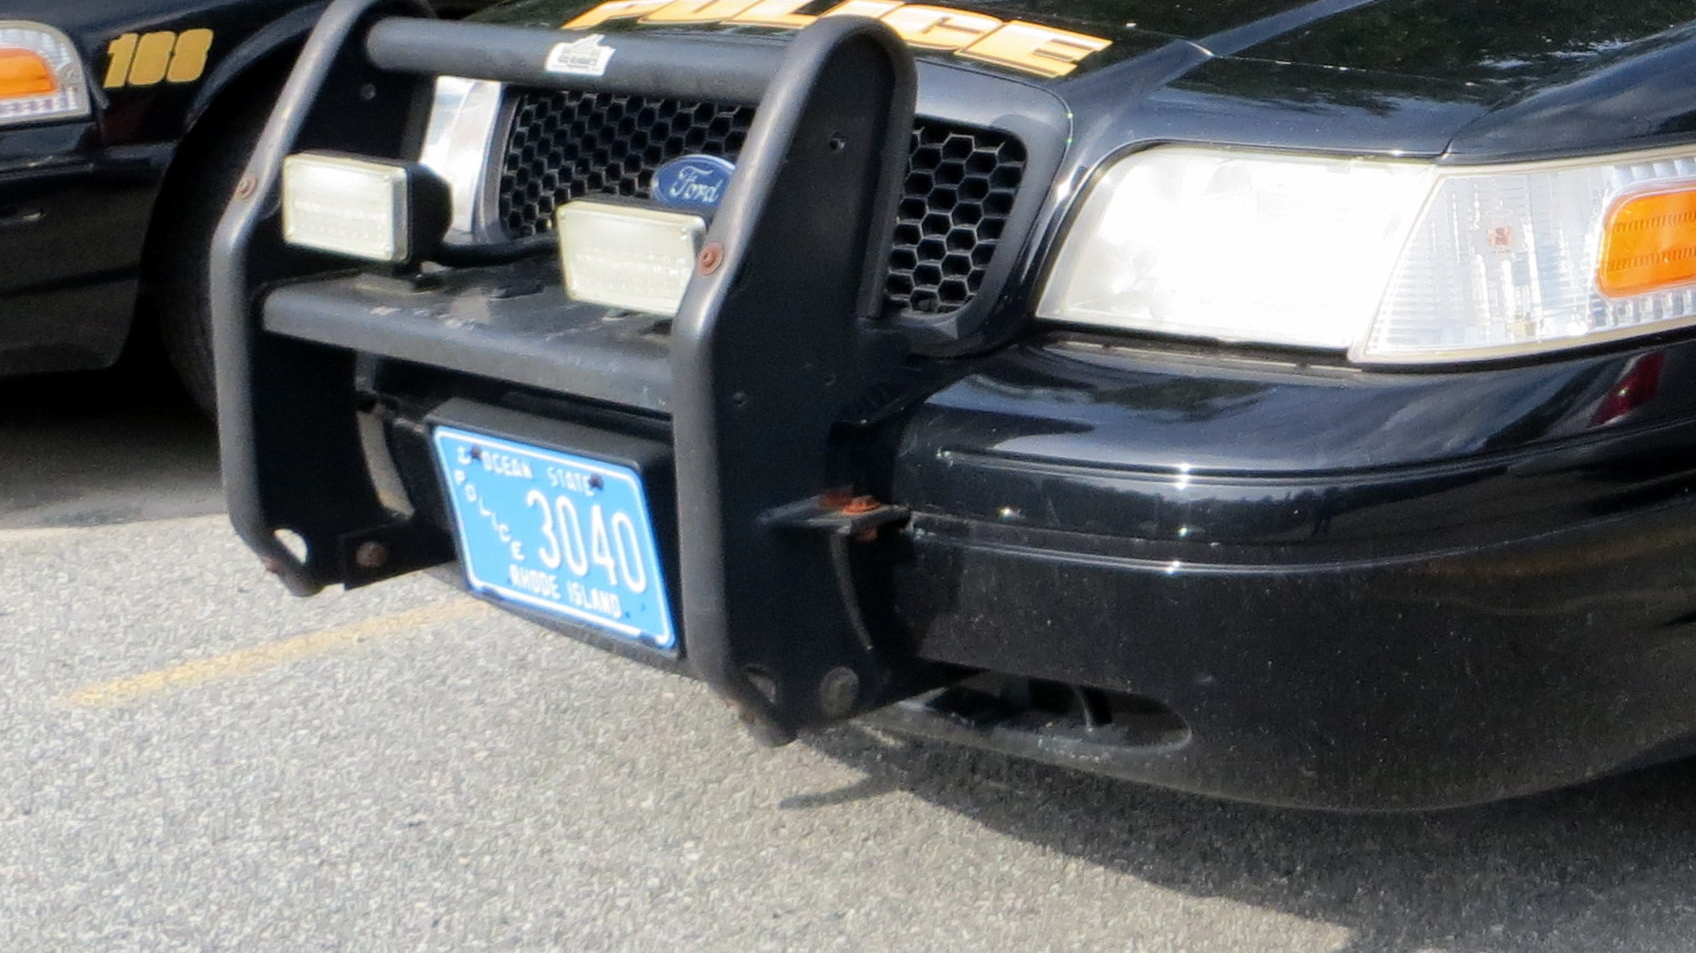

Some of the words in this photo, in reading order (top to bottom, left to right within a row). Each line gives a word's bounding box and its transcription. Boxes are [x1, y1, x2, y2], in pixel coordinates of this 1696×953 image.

[669, 166, 725, 203] Ford
[482, 451, 533, 479] OCEAN
[454, 469, 526, 560] POLICE
[526, 489, 647, 593] 3040
[509, 564, 561, 600] RHODE
[567, 581, 622, 619] ISLAND
